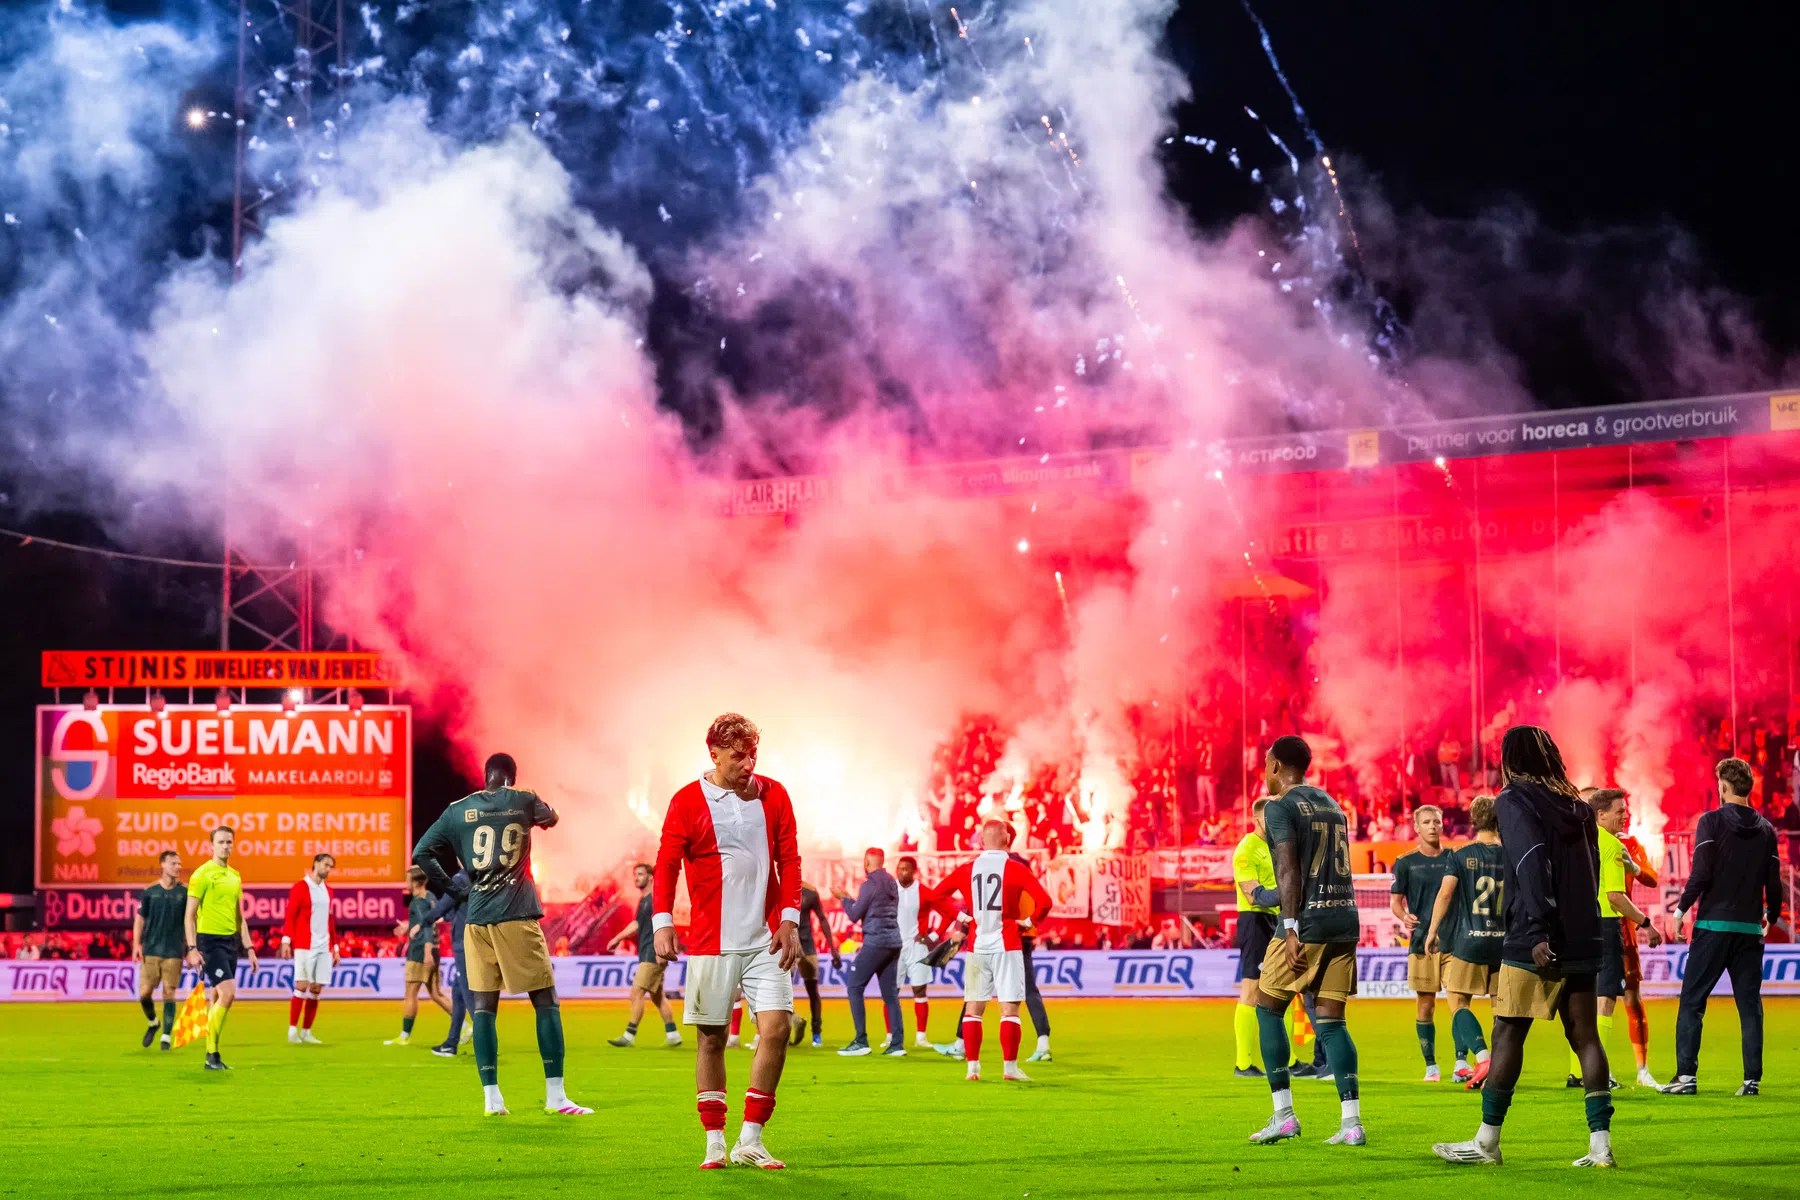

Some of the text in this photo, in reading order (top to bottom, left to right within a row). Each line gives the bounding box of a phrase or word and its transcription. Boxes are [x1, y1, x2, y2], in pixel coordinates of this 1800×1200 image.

[1407, 406, 1738, 453] partner voor horeca & grootverbruik
[1239, 446, 1318, 463] ACTIFOOD
[85, 656, 187, 686] STIJNIS
[195, 658, 283, 680] JUWELIERS
[288, 659, 319, 680] VAN
[133, 718, 393, 756] SUELMANN
[133, 761, 375, 791] RegioBank MAKELAARDIJ
[277, 811, 391, 833] DRENTHE
[117, 839, 178, 857] BRON
[238, 839, 296, 857] ONZE
[303, 839, 391, 857] ENERGIE
[472, 822, 524, 870] 99
[1308, 821, 1351, 879] 75
[54, 863, 100, 880] NAM
[66, 891, 141, 920] Dutch
[972, 873, 1002, 911] 12
[8, 965, 69, 995] TinQ
[81, 965, 136, 995] TinQ
[330, 963, 381, 993] inQ
[1108, 955, 1194, 990] TinQ
[1356, 953, 1408, 982] Tin
[1366, 983, 1409, 997] HYDR
